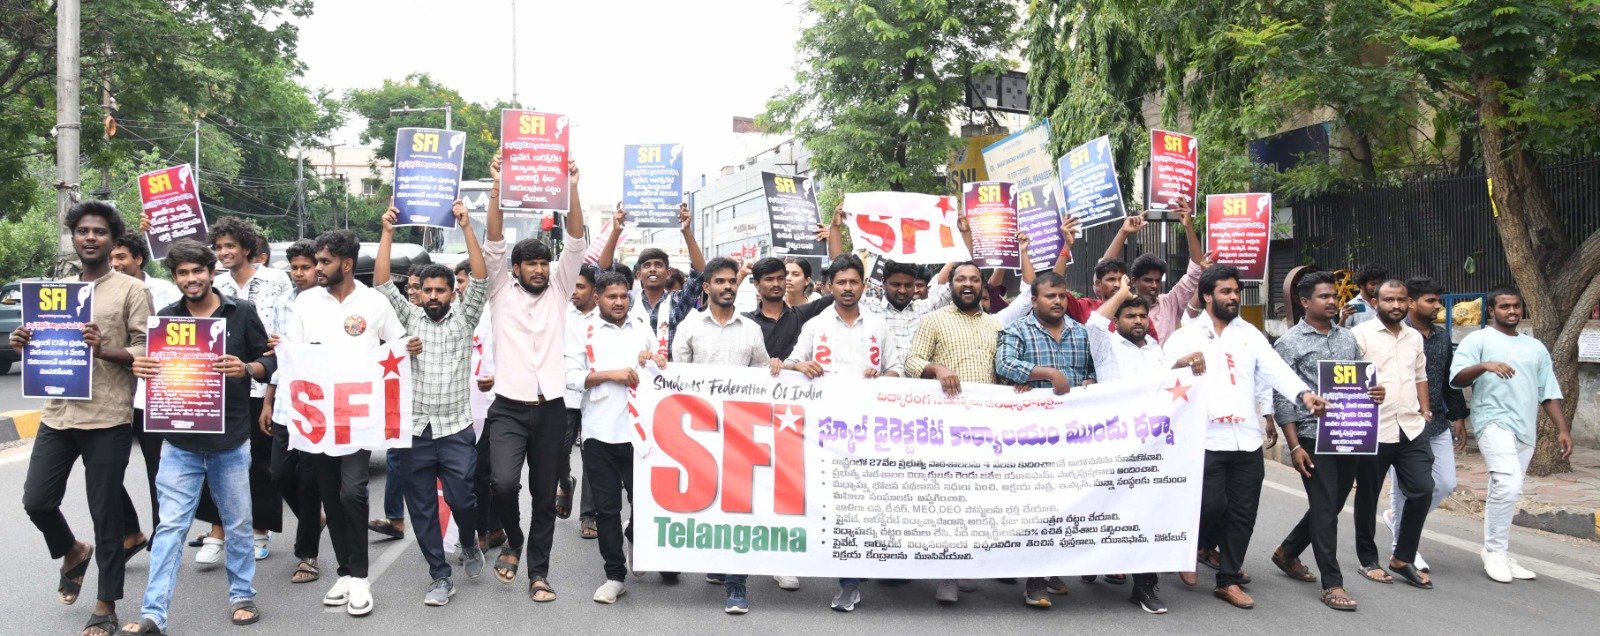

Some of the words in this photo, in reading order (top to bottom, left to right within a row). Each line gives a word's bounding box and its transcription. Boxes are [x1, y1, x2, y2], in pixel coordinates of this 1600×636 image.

[520, 115, 544, 134] SFI
[412, 133, 439, 152] SFI
[1164, 135, 1182, 152] SFI
[638, 146, 661, 162] SFI
[1070, 147, 1089, 170] SFI
[148, 174, 172, 194] SFI
[774, 176, 796, 194] SFI
[978, 186, 1001, 202] SFI
[1223, 198, 1246, 216] SFI
[40, 288, 66, 310] SFI
[166, 323, 196, 346] SFI
[1334, 365, 1356, 384] SFI
[654, 375, 704, 392] Students'
[709, 379, 766, 396] Federation
[772, 383, 787, 400] Of
[792, 384, 822, 400] India
[290, 378, 400, 444] SFI
[818, 415, 868, 453] స్కూల్
[950, 423, 1060, 456] కార్యాలయం
[1066, 416, 1128, 444] ముందు
[1134, 413, 1175, 446] ధర్నా
[650, 394, 806, 516] SFI
[870, 458, 896, 467] 27వేల
[898, 459, 926, 470] ప్రభుత్వ
[832, 469, 860, 478] ప్రభుత్వ
[907, 470, 952, 482] విద్యార్థులకు
[955, 471, 978, 480] రెండు
[980, 472, 1002, 480] జతల
[872, 482, 898, 490] భోజన
[944, 484, 970, 492] నిధులు
[1002, 483, 1030, 493] అక్షయ
[1117, 477, 1150, 489] సంస్థలకు
[1153, 476, 1186, 484] కాకుండా
[869, 492, 912, 502] సంఘాలకు
[836, 504, 864, 512] ఖాళీగా
[867, 505, 884, 516] ఉన్న
[964, 506, 1003, 518] పోస్టులను
[1005, 506, 1020, 516] భర్తీ
[1021, 516, 1063, 526] నియంత్రణ
[1066, 514, 1086, 526] చట్టం
[654, 516, 806, 554] Telangana
[833, 527, 878, 538] విద్యాహక్కు
[880, 528, 901, 540] చట్టం
[903, 529, 931, 537] అమలు
[954, 528, 968, 537] పేద
[1041, 527, 1063, 536] ఉచిత
[1065, 526, 1098, 536] ప్రవేశాలు
[1026, 538, 1054, 548] తెరిచిన
[832, 551, 861, 560] విక్రయ
[866, 551, 908, 562] కేంద్రాలను
